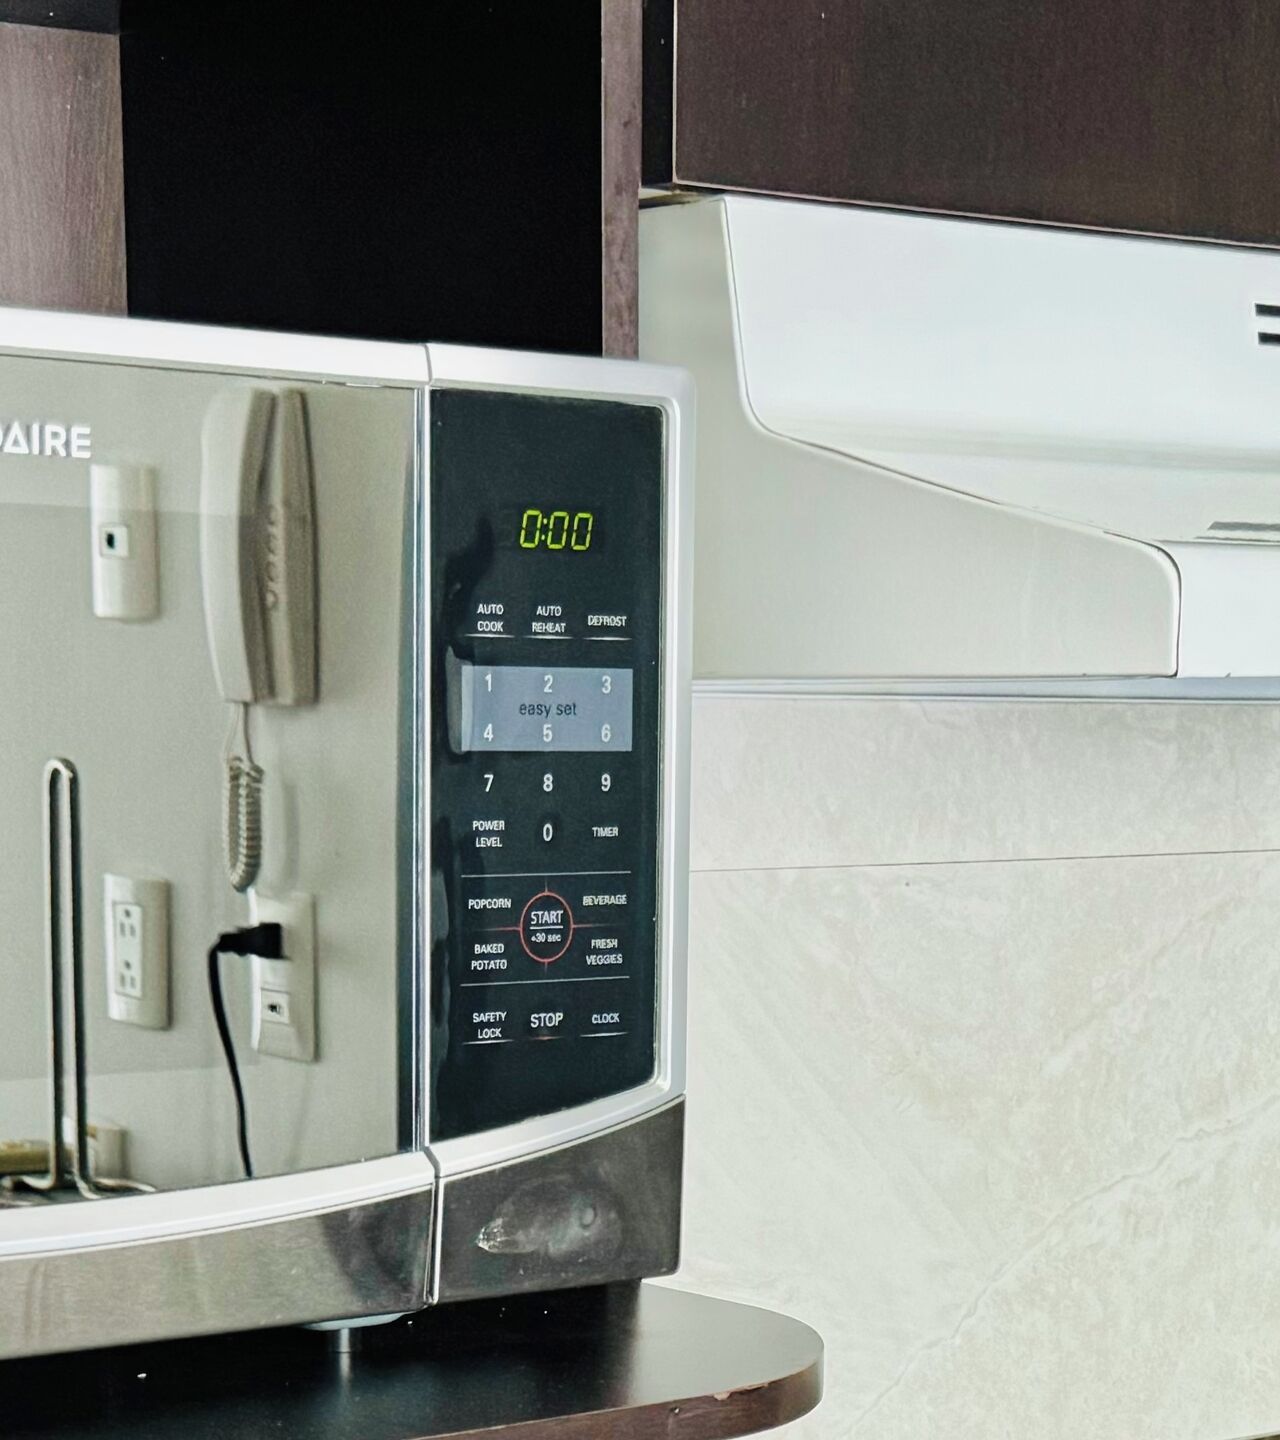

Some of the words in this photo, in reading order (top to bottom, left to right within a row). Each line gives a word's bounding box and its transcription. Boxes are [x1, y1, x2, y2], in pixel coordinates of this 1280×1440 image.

[519, 508, 594, 551] 0:00
[476, 603, 505, 615] AUTO
[536, 605, 563, 617] AUTO
[477, 621, 504, 632] COOK
[587, 615, 627, 627] DEFROST
[531, 622, 567, 634] REHEAT
[484, 673, 493, 693] 1
[543, 674, 554, 694] 2
[601, 675, 612, 695] 3
[519, 703, 551, 719] easy
[556, 701, 578, 716] set
[483, 723, 494, 742] 4
[542, 723, 553, 742] 5
[601, 723, 612, 742] 6
[483, 773, 494, 793] 7
[542, 773, 554, 792] 8
[601, 773, 612, 792] 9
[472, 820, 505, 832] POWER
[542, 822, 553, 842] 0
[592, 826, 619, 838] TIMER
[475, 837, 503, 848] LEVEL
[468, 898, 512, 910] POPCORN
[582, 894, 628, 907] BEVERAGE
[530, 909, 563, 925] START
[547, 933, 562, 943] sec
[591, 938, 618, 949] FRESH
[474, 943, 504, 955] BAKED
[471, 959, 508, 971] POTATO
[586, 953, 623, 966] VEGGIES
[472, 1011, 507, 1023] SAFETY
[530, 1012, 563, 1028] STOP
[592, 1013, 620, 1025] CLOCK
[477, 1027, 502, 1039] LOCK
